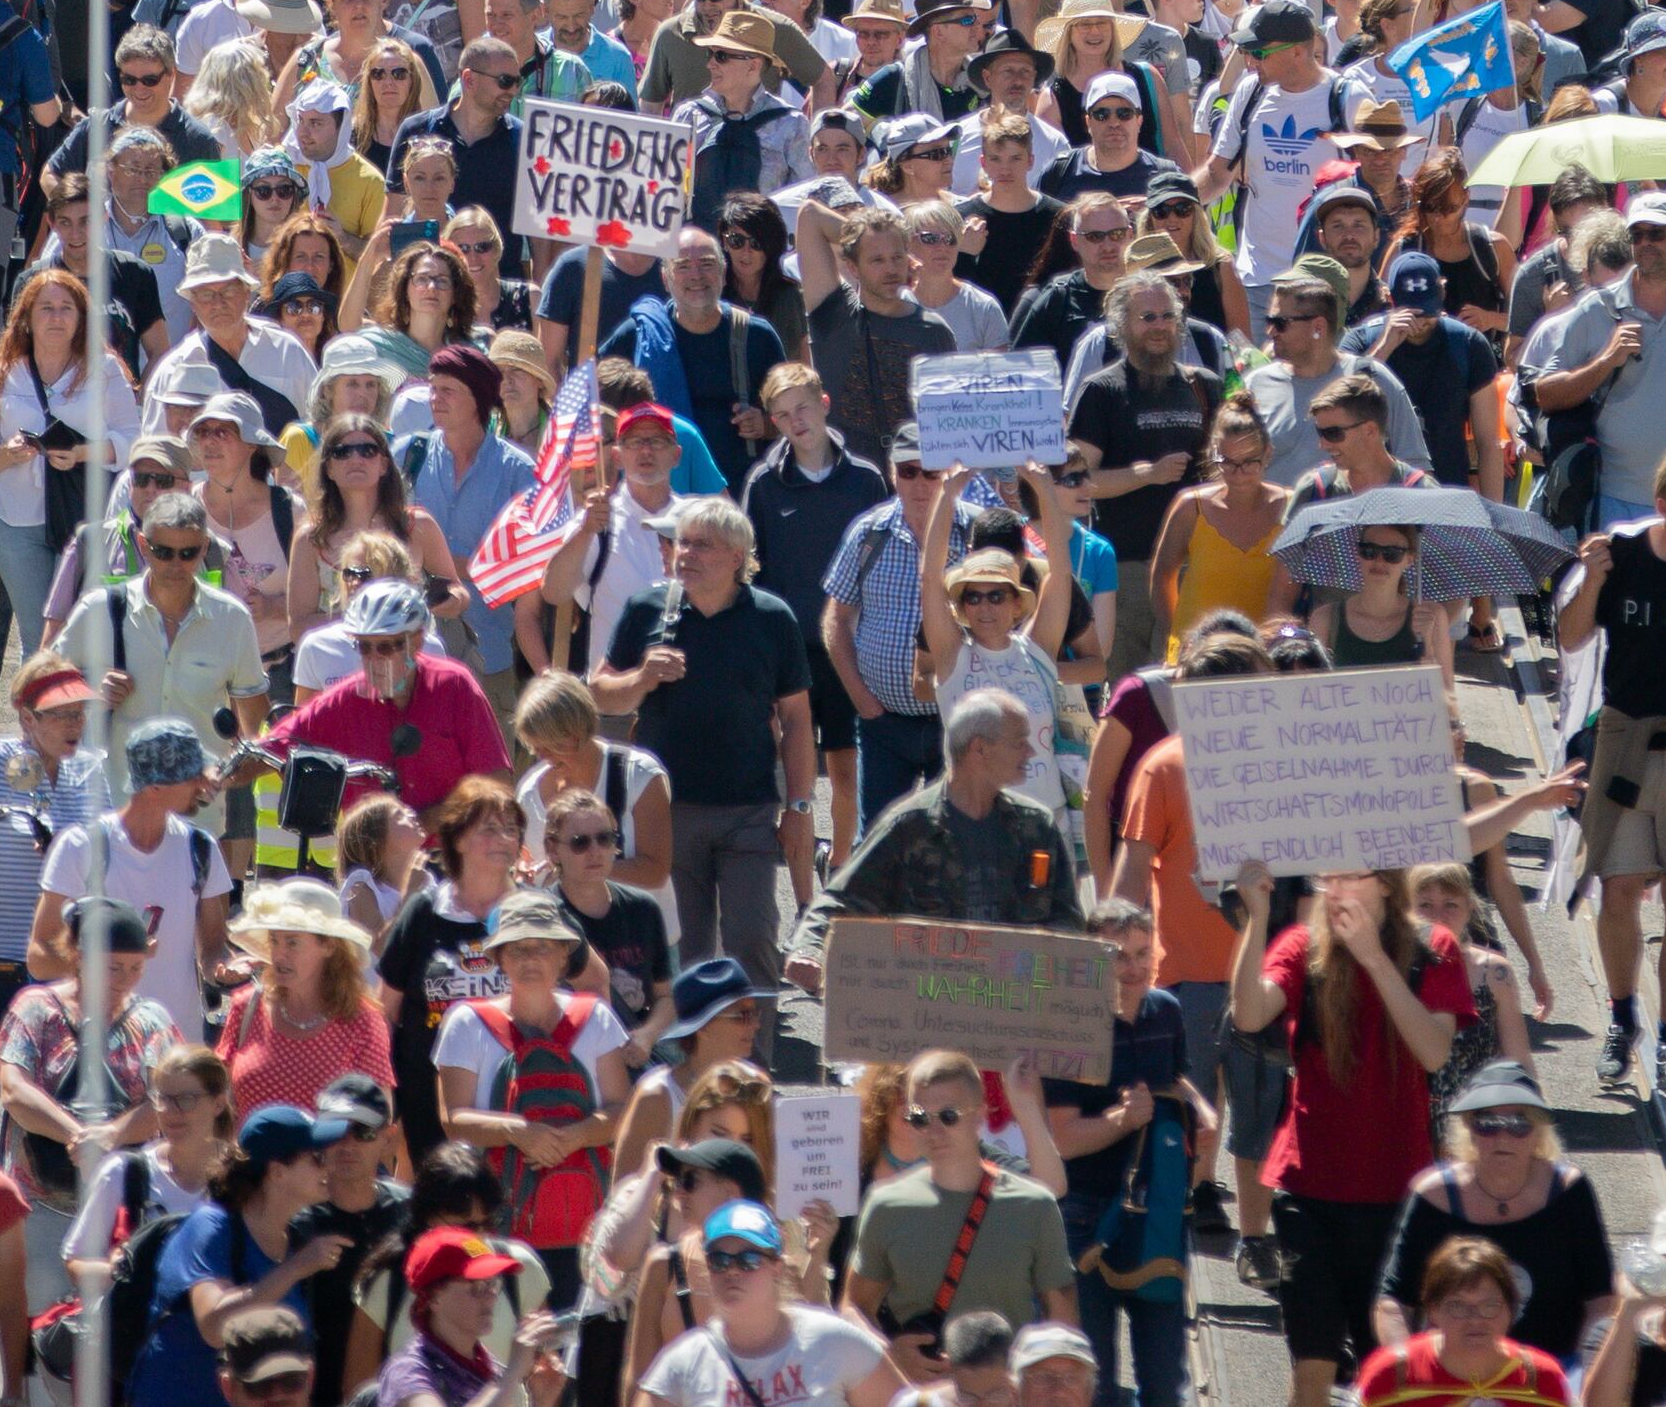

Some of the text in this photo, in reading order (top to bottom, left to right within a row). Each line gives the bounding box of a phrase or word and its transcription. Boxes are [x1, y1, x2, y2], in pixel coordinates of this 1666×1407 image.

[1263, 155, 1310, 176] berlin
[528, 167, 681, 233] VERTRAG
[937, 412, 1002, 433] KRANKEN
[971, 430, 1036, 454] VIREN
[1182, 678, 1434, 721] WEDER ALTE NOCH
[1191, 714, 1437, 755] NEUE NORMALITÄT!
[1188, 753, 1456, 791] DIE GEISELNAHME DURCH
[1198, 785, 1450, 828] WIRTSCHAFTSMONOPOLE
[1202, 819, 1460, 870] MUSS ENDLICH BEENDET
[916, 974, 1050, 1017] WAHRHEIT
[802, 1110, 830, 1122] WIR
[791, 1135, 844, 1150] geboren
[806, 1153, 826, 1163] um
[802, 1165, 831, 1177] FREI
[792, 1179, 843, 1192] zu sein!
